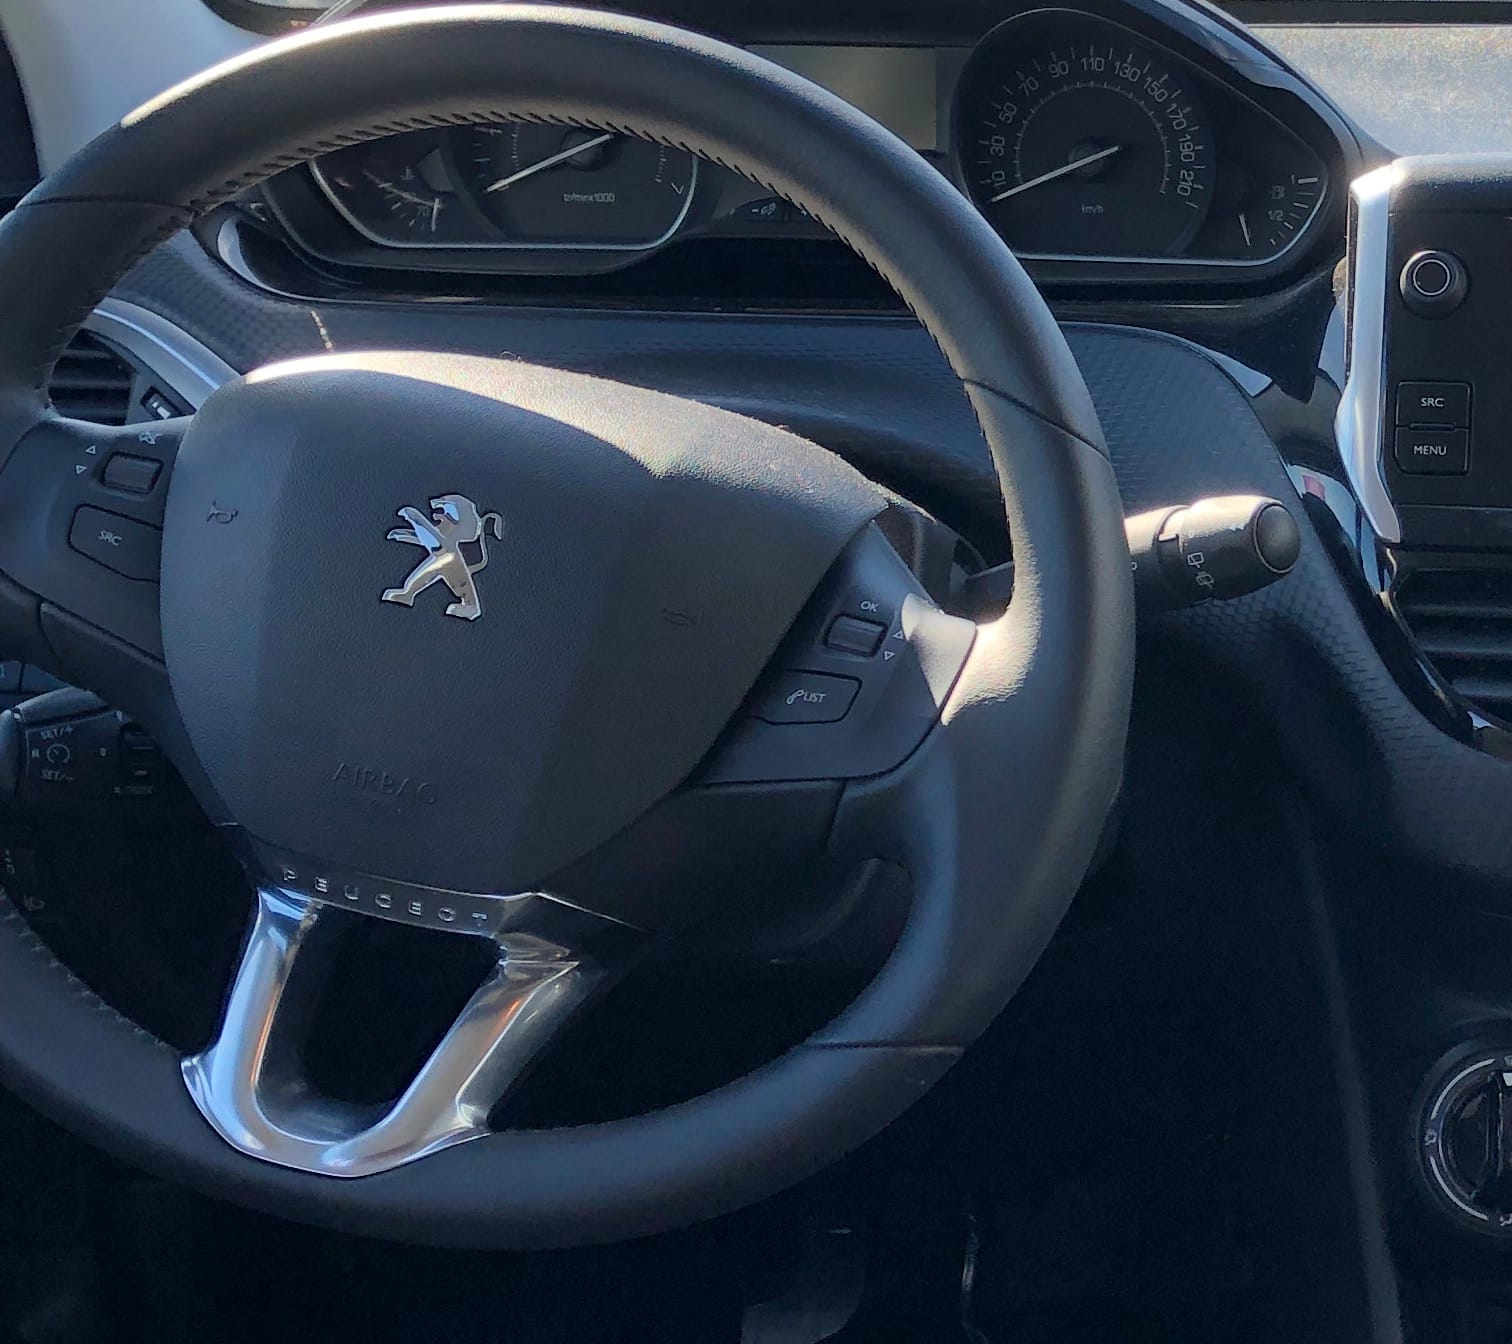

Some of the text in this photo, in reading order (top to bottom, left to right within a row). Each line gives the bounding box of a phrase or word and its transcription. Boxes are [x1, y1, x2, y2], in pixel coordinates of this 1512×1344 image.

[1048, 60, 1070, 78] 90
[1080, 56, 1106, 72] 110
[1113, 61, 1142, 83] 130
[1017, 75, 1040, 96] 70
[1142, 76, 1168, 103] 150
[998, 102, 1018, 124] 50
[1165, 103, 1187, 131] 170
[990, 135, 1006, 157] 30
[1177, 133, 1195, 164] 190
[991, 170, 1007, 188] 10
[1177, 169, 1195, 197] 210
[1420, 397, 1445, 408] SRC
[1413, 445, 1448, 456] MENU
[98, 530, 122, 546] SRC
[860, 600, 879, 612] OK
[803, 692, 826, 704] LIST
[283, 868, 488, 928] PEUGEOT
